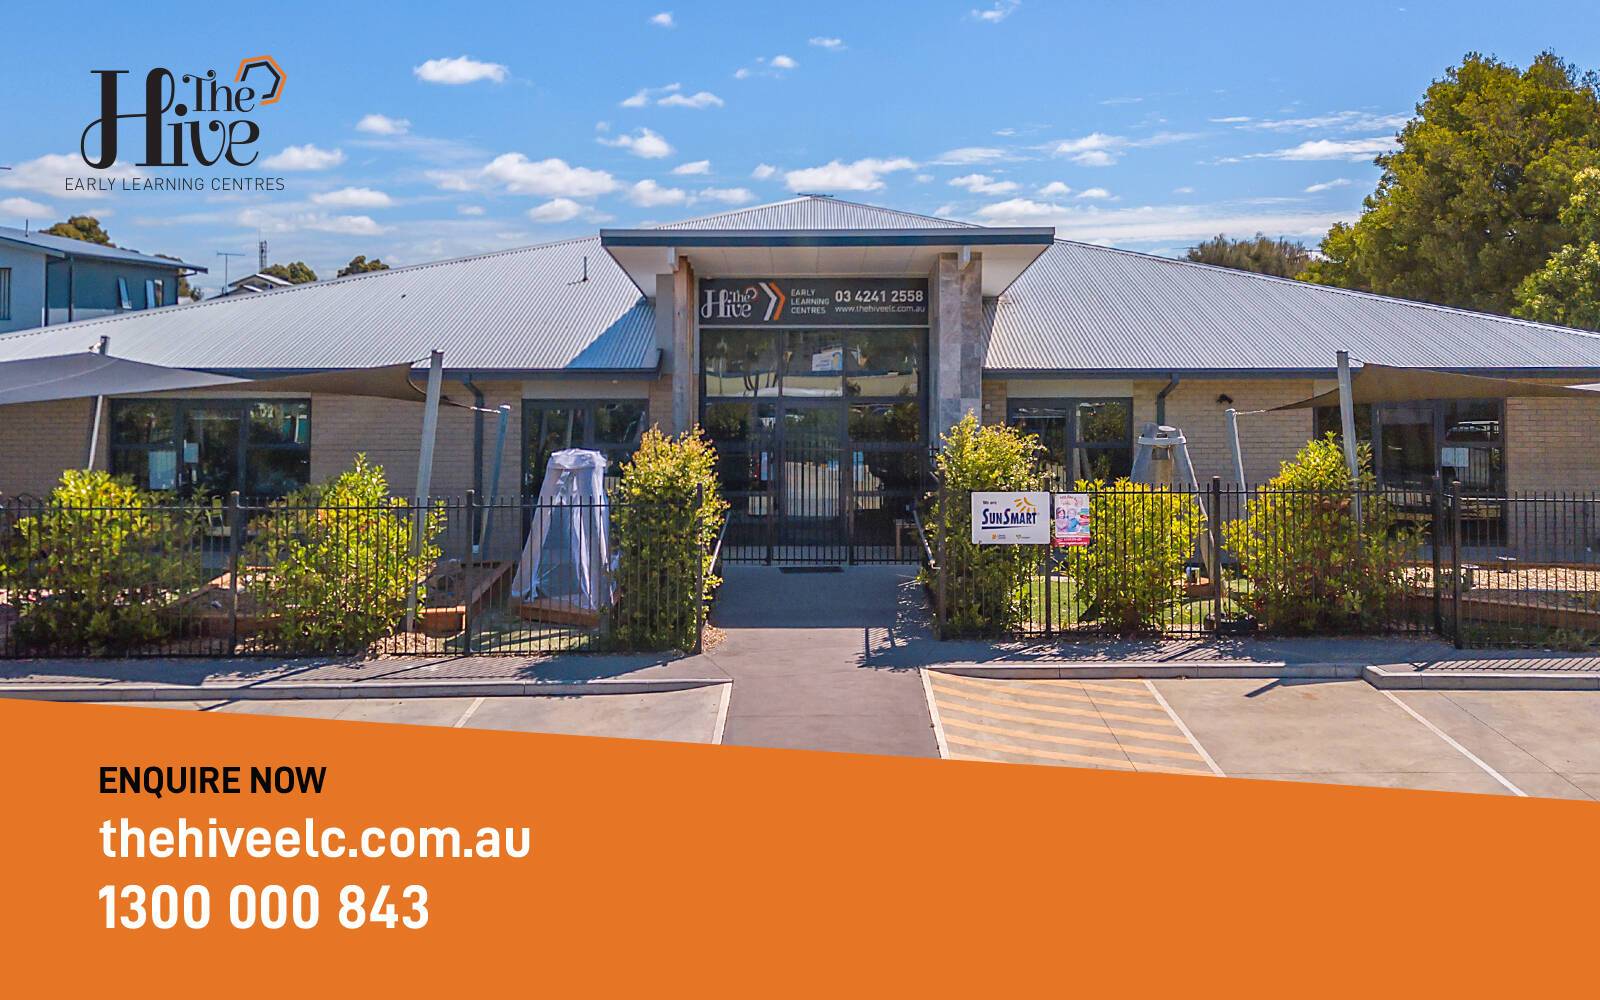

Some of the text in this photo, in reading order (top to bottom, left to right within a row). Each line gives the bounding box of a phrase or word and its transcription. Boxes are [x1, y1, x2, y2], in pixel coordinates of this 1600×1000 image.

[790, 288, 817, 297] EARLY
[834, 290, 925, 303] 03 4241 2558
[701, 289, 752, 318] Hive
[790, 297, 830, 306] LEARNING
[790, 306, 827, 315] CENTRES
[834, 304, 926, 314] www.thehiveelc.com.au
